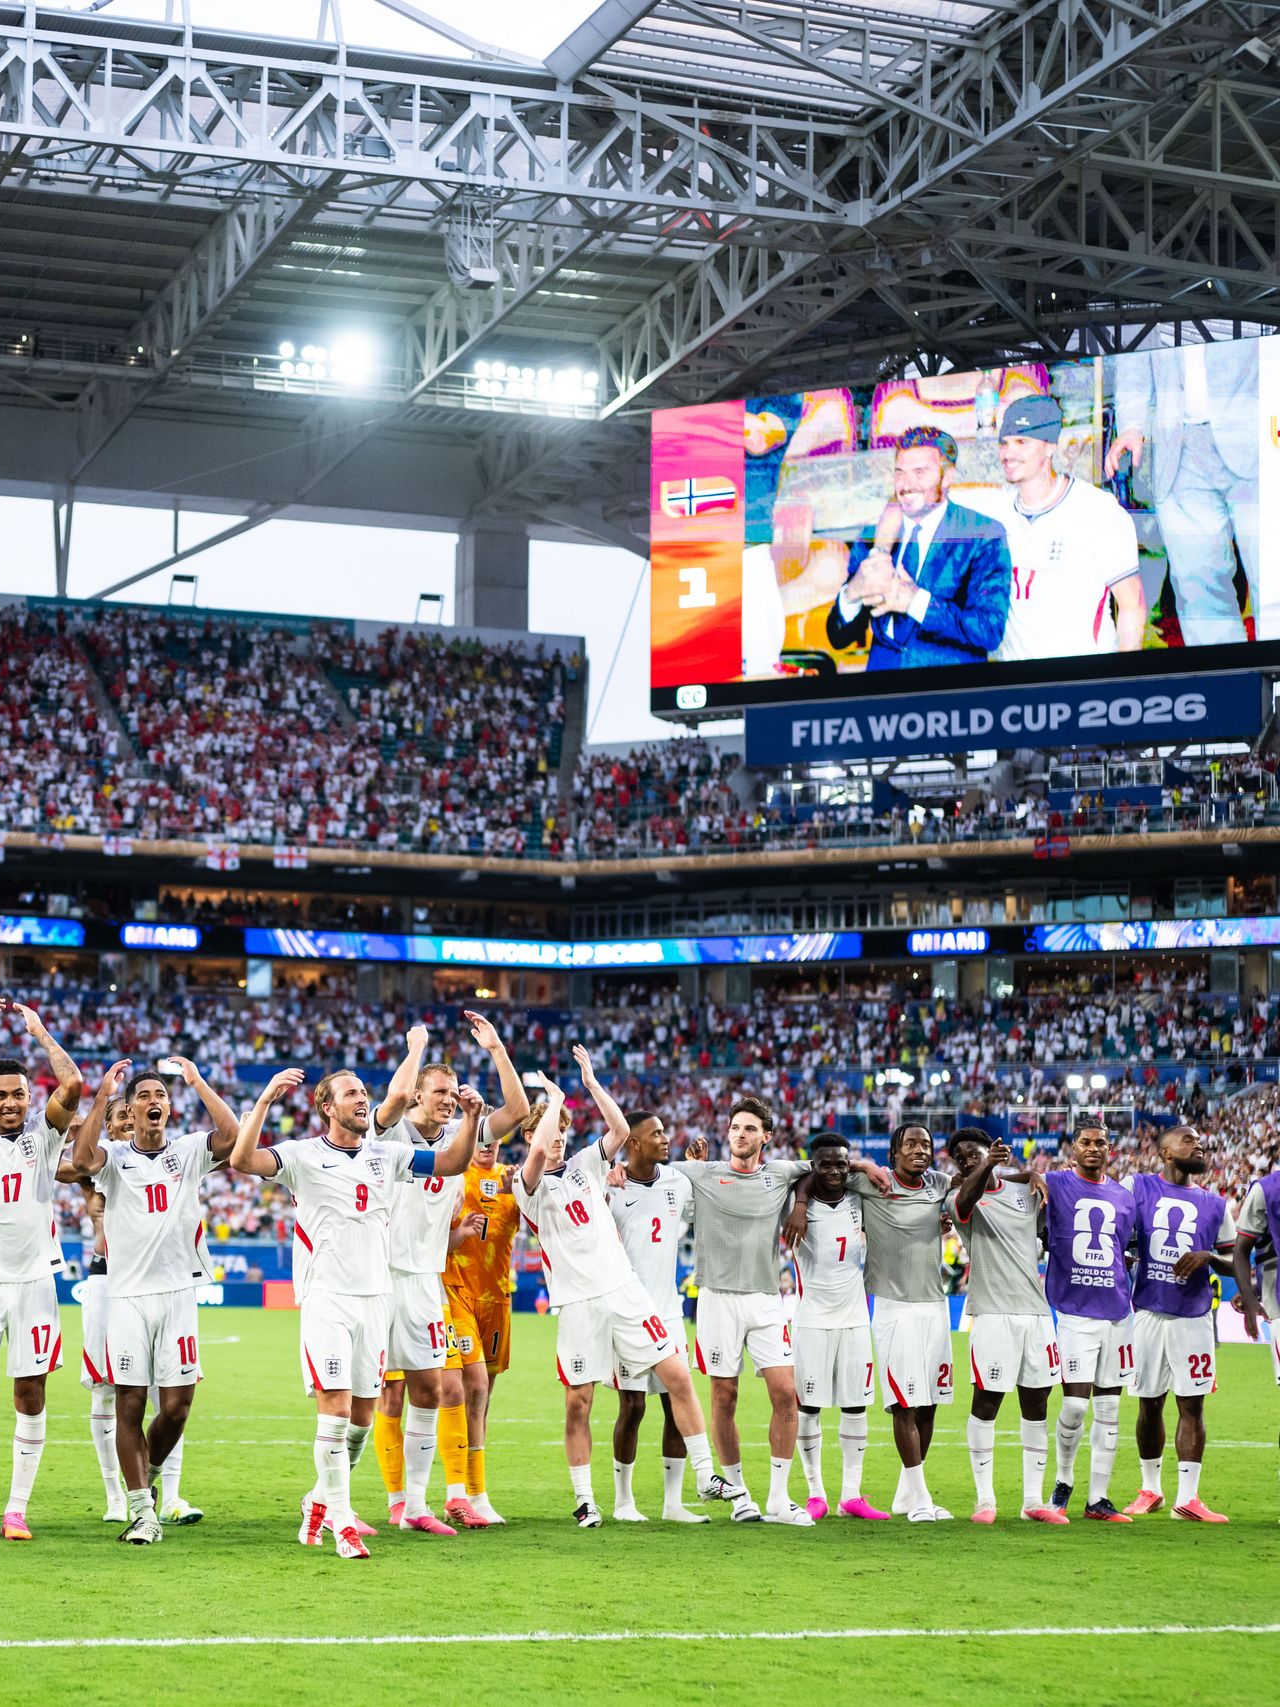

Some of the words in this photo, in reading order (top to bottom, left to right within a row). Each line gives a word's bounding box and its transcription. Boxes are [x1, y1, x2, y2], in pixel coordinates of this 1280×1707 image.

[678, 567, 717, 609] 1
[681, 689, 702, 704] CC
[791, 717, 863, 748] FIFA
[868, 708, 994, 742] WORLD
[1000, 702, 1072, 733] CUP
[1078, 693, 1207, 728] 2026
[123, 925, 197, 949] MIAMI
[911, 931, 986, 952] MIAMI
[1, 1172, 22, 1203] 17
[145, 1183, 168, 1213] 10
[355, 1183, 368, 1212] 9
[564, 1199, 590, 1227] 18
[651, 1217, 661, 1243] 2
[836, 1236, 847, 1262] 7
[1085, 1252, 1104, 1261] FIFA
[1160, 1248, 1180, 1259] FIFA
[1070, 1274, 1115, 1288] 2026
[1071, 1267, 1099, 1276] WORLD
[1100, 1269, 1115, 1277] CUP
[1147, 1262, 1173, 1273] WORLD
[30, 1324, 51, 1355] 17
[427, 1321, 445, 1350] 15
[642, 1314, 668, 1344] 18
[177, 1335, 197, 1366] 10
[491, 1330, 499, 1356] 1
[1046, 1341, 1060, 1369] 16
[1118, 1343, 1134, 1370] 11
[865, 1362, 873, 1388] 7
[1188, 1352, 1213, 1379] 22
